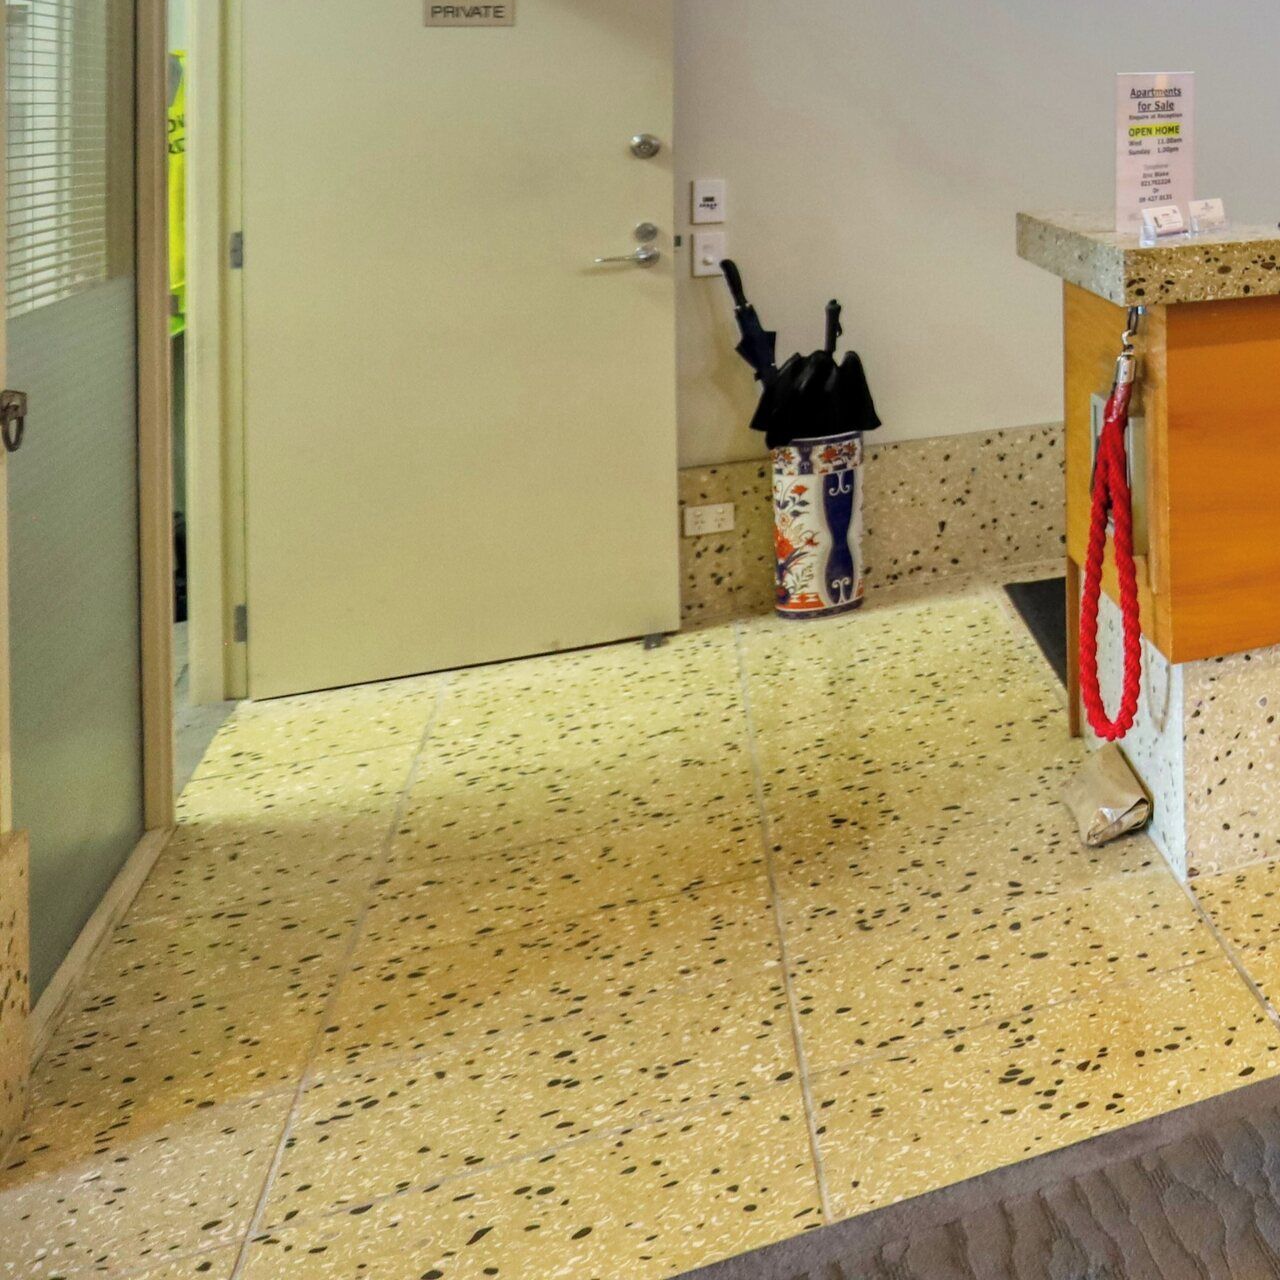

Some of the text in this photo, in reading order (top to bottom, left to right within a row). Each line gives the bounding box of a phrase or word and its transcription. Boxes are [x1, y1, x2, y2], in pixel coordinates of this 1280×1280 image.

[431, 5, 505, 18] PRIVATE
[1131, 88, 1182, 98] Apartments
[1138, 100, 1174, 112] for Sale
[1129, 125, 1180, 137] OPEN HOME
